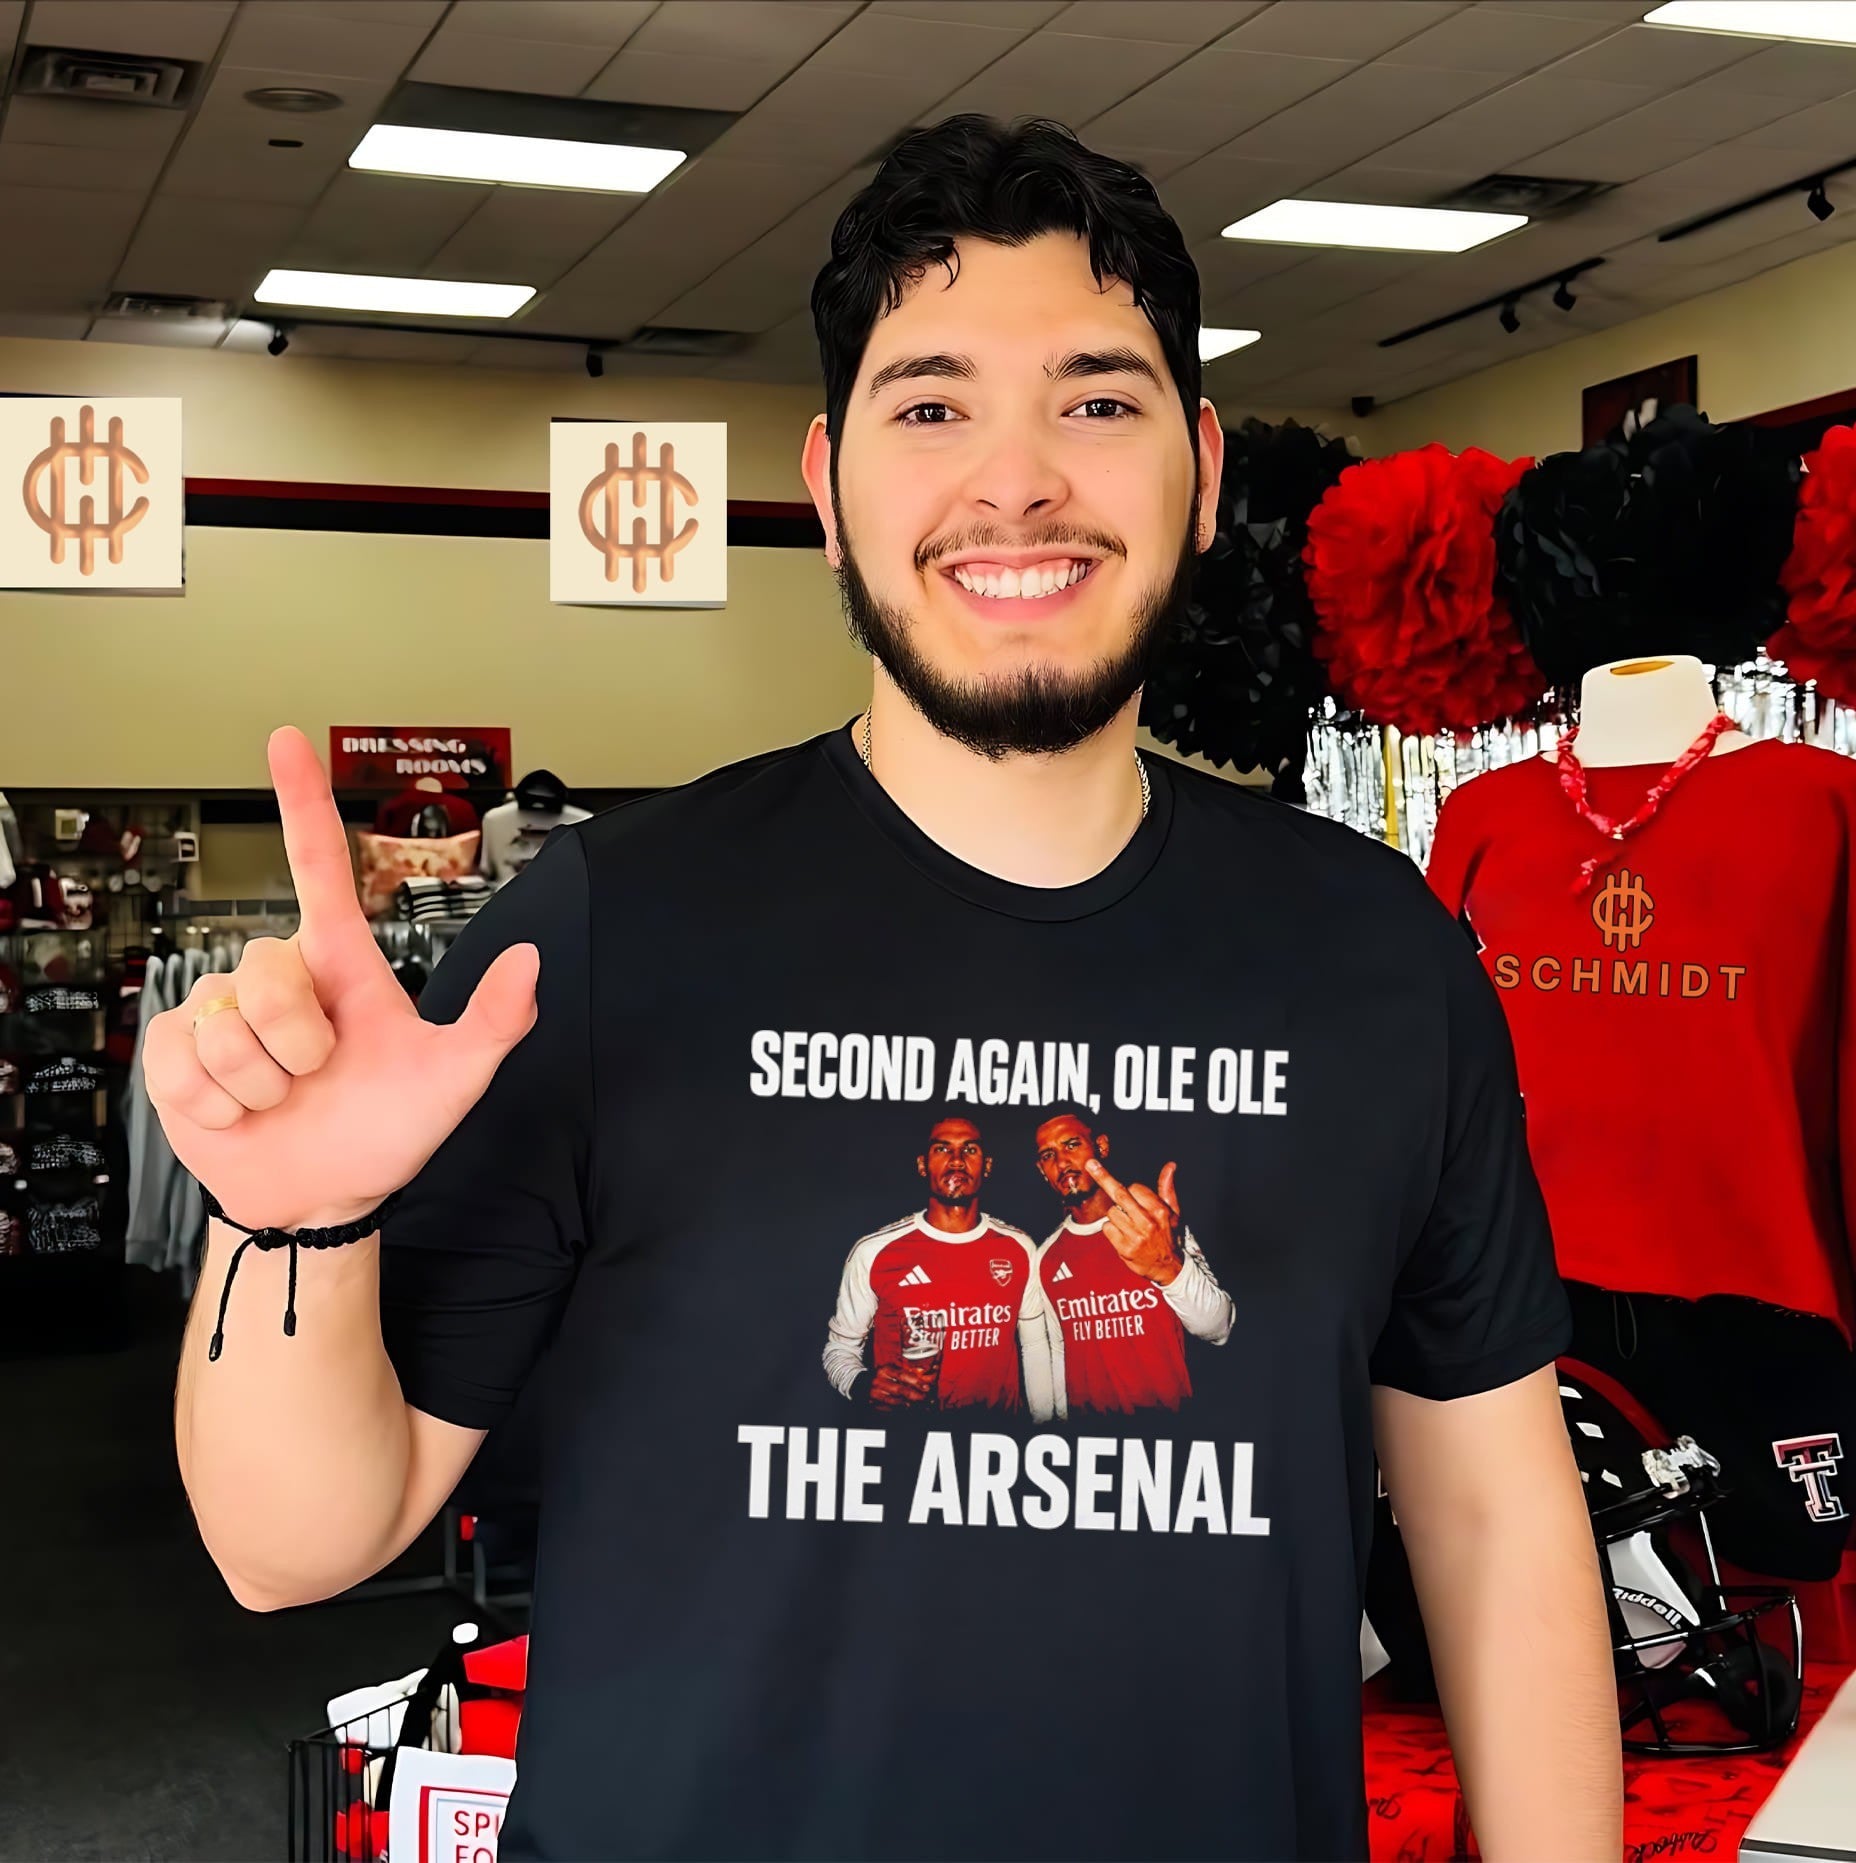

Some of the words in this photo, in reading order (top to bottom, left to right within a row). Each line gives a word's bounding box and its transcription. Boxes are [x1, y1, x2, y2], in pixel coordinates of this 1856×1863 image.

[1494, 954, 1747, 1000] SCHMIDT
[750, 1030, 935, 1102] SECOND
[945, 1038, 1100, 1115] AGAIN,
[1113, 1044, 1196, 1112] OLE
[1207, 1047, 1289, 1116] OLE
[903, 1301, 1011, 1329] Emirates
[1056, 1287, 1159, 1321] Emirates
[950, 1327, 1000, 1351] BETTER
[1073, 1321, 1091, 1341] FLY
[1095, 1314, 1145, 1340] BETTER
[737, 1424, 887, 1523] THE
[908, 1431, 1271, 1536] ARSENAL
